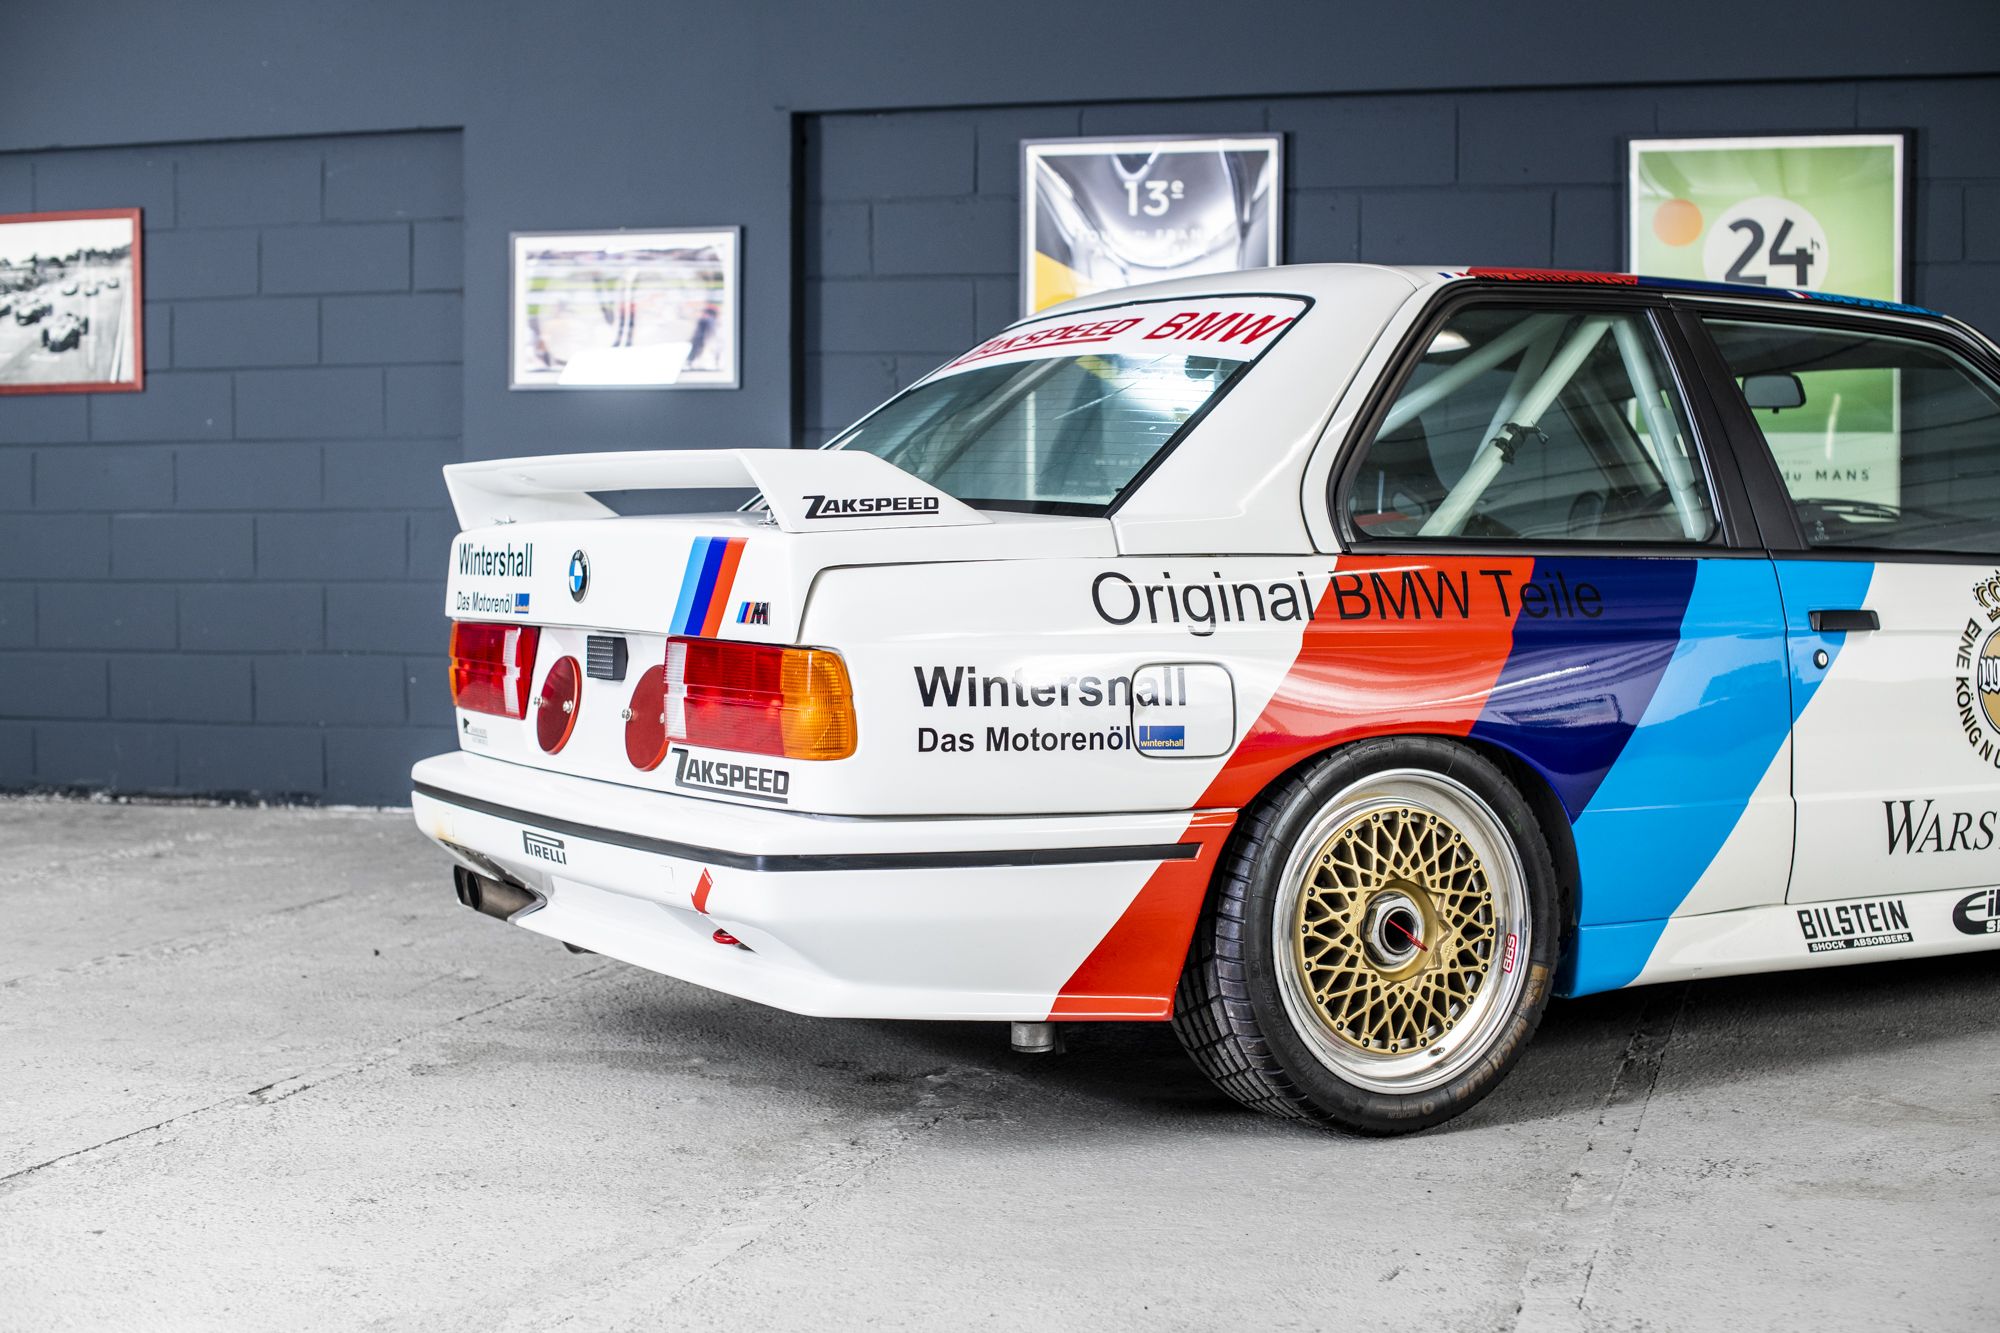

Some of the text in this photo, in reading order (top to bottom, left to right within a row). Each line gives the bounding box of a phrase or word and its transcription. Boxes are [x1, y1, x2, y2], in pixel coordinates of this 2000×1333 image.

[1142, 311, 1295, 345] BMW
[1816, 469, 1870, 482] MANS
[802, 495, 939, 519] ZAKSPEED
[459, 543, 533, 577] Wintershall
[456, 591, 513, 614] Das Motorenöl
[1092, 569, 1604, 637] Original BMW Teile
[1956, 617, 1982, 670] EINE
[918, 725, 1131, 752] Das Motorenöl
[671, 747, 789, 804] ZAKSPEED
[1882, 799, 2000, 856] WARS
[522, 830, 567, 865] PIRELLI
[1797, 900, 1910, 940] BILSTEIN
[1503, 933, 1516, 972] BBS
[1811, 933, 1911, 952] SHOCK ABSORBERS
